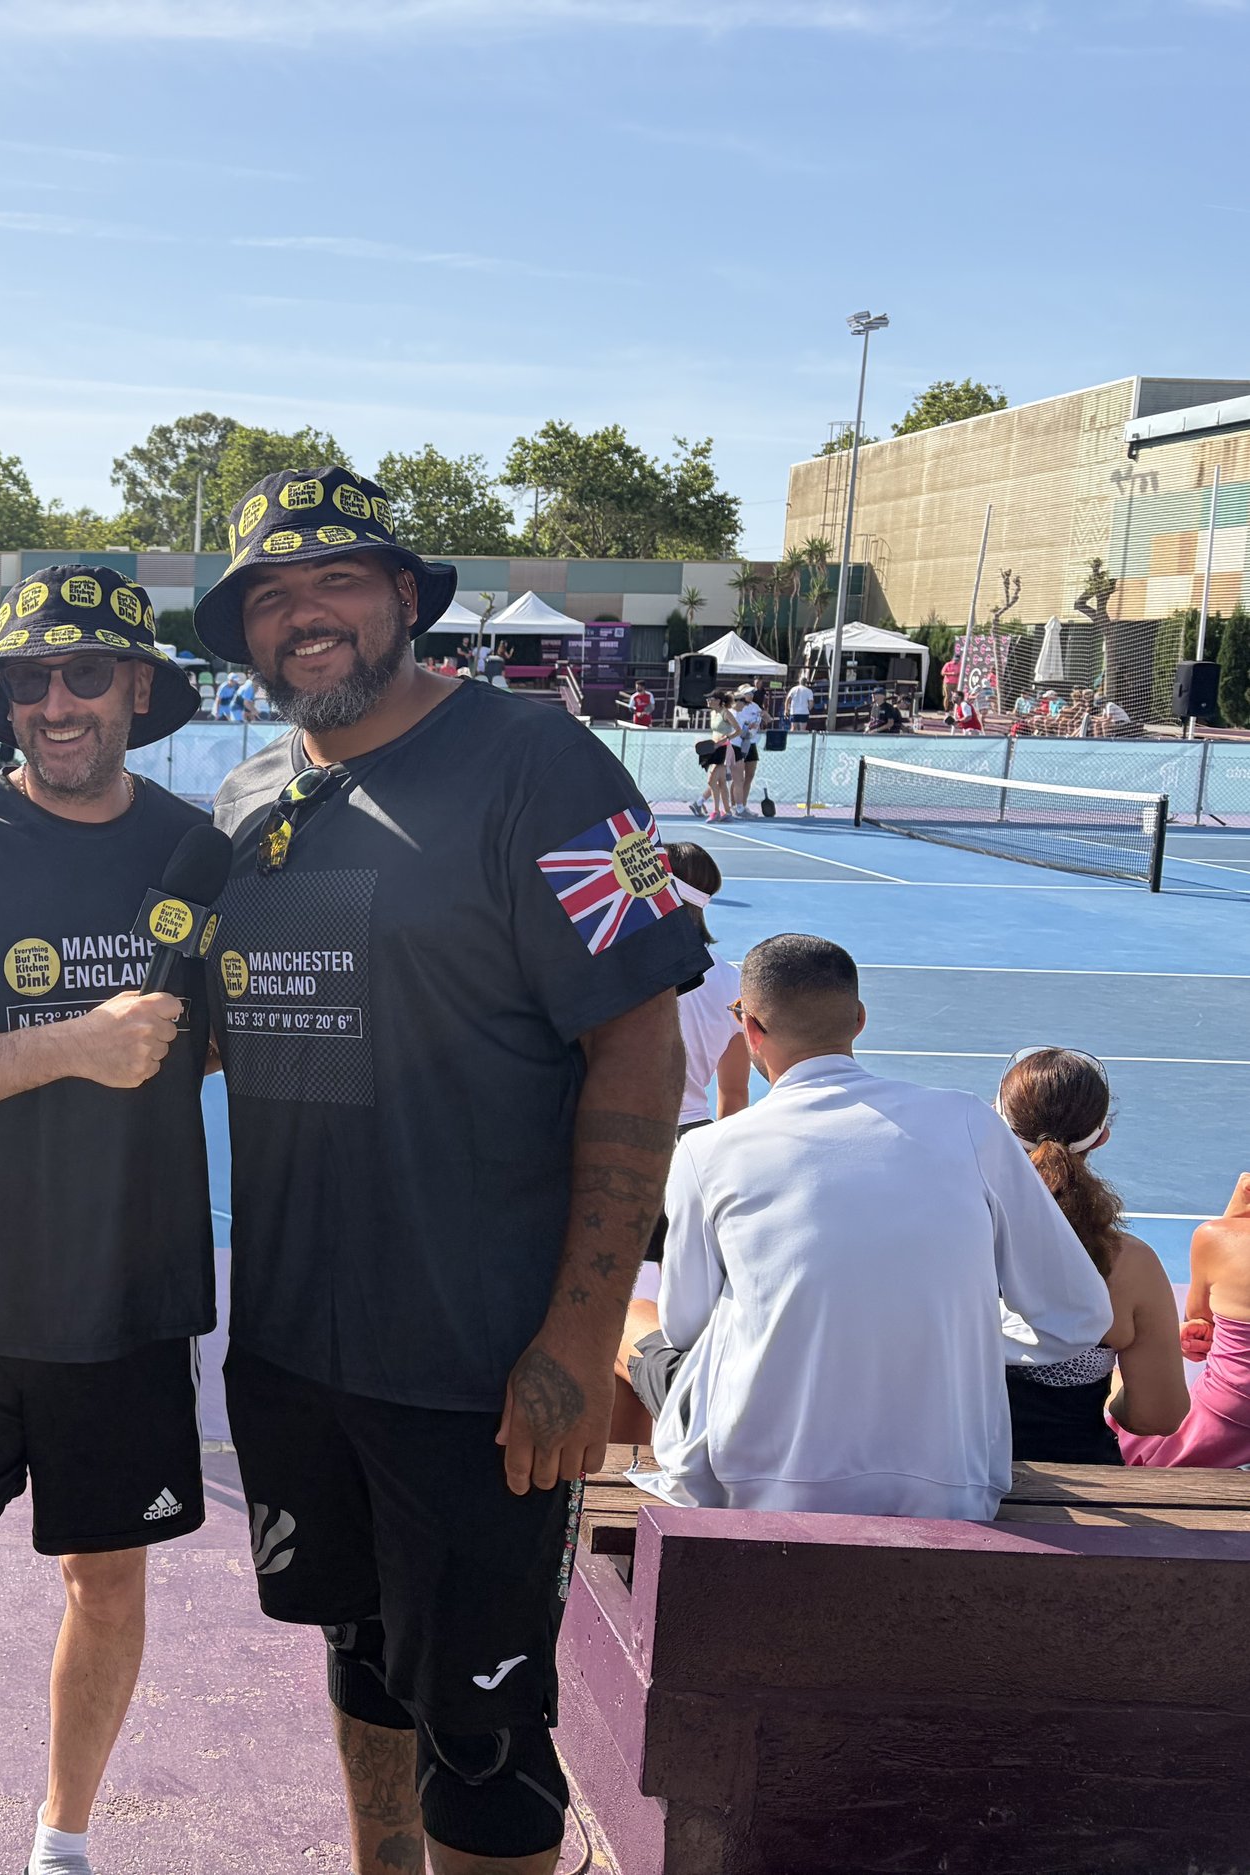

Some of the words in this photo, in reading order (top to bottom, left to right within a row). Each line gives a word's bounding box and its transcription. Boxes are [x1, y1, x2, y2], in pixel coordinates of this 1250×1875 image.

[288, 495, 316, 507] Dink
[342, 506, 367, 518] Dink
[22, 599, 39, 615] Dink
[70, 594, 95, 605] Dink
[119, 605, 136, 623] Dink
[616, 836, 651, 857] Everything
[620, 853, 636, 867] But
[636, 845, 655, 858] The
[624, 854, 659, 877] Kitchen
[630, 863, 668, 893] Dink
[161, 908, 173, 917] But
[174, 912, 186, 921] The
[163, 903, 187, 916] Everything
[158, 914, 183, 928] Kitchen
[154, 922, 180, 939] Dink
[14, 946, 48, 954] Everything
[15, 955, 30, 964] But
[33, 953, 49, 962] The
[249, 951, 354, 972] MANCHESTER
[15, 963, 49, 974] Kitchen
[64, 962, 150, 989] ENGLAN
[17, 972, 50, 988] Dink
[250, 976, 316, 995] ENGLAND
[227, 1011, 233, 1025] N
[283, 1014, 291, 1028] W
[143, 1503, 182, 1521] adidas
